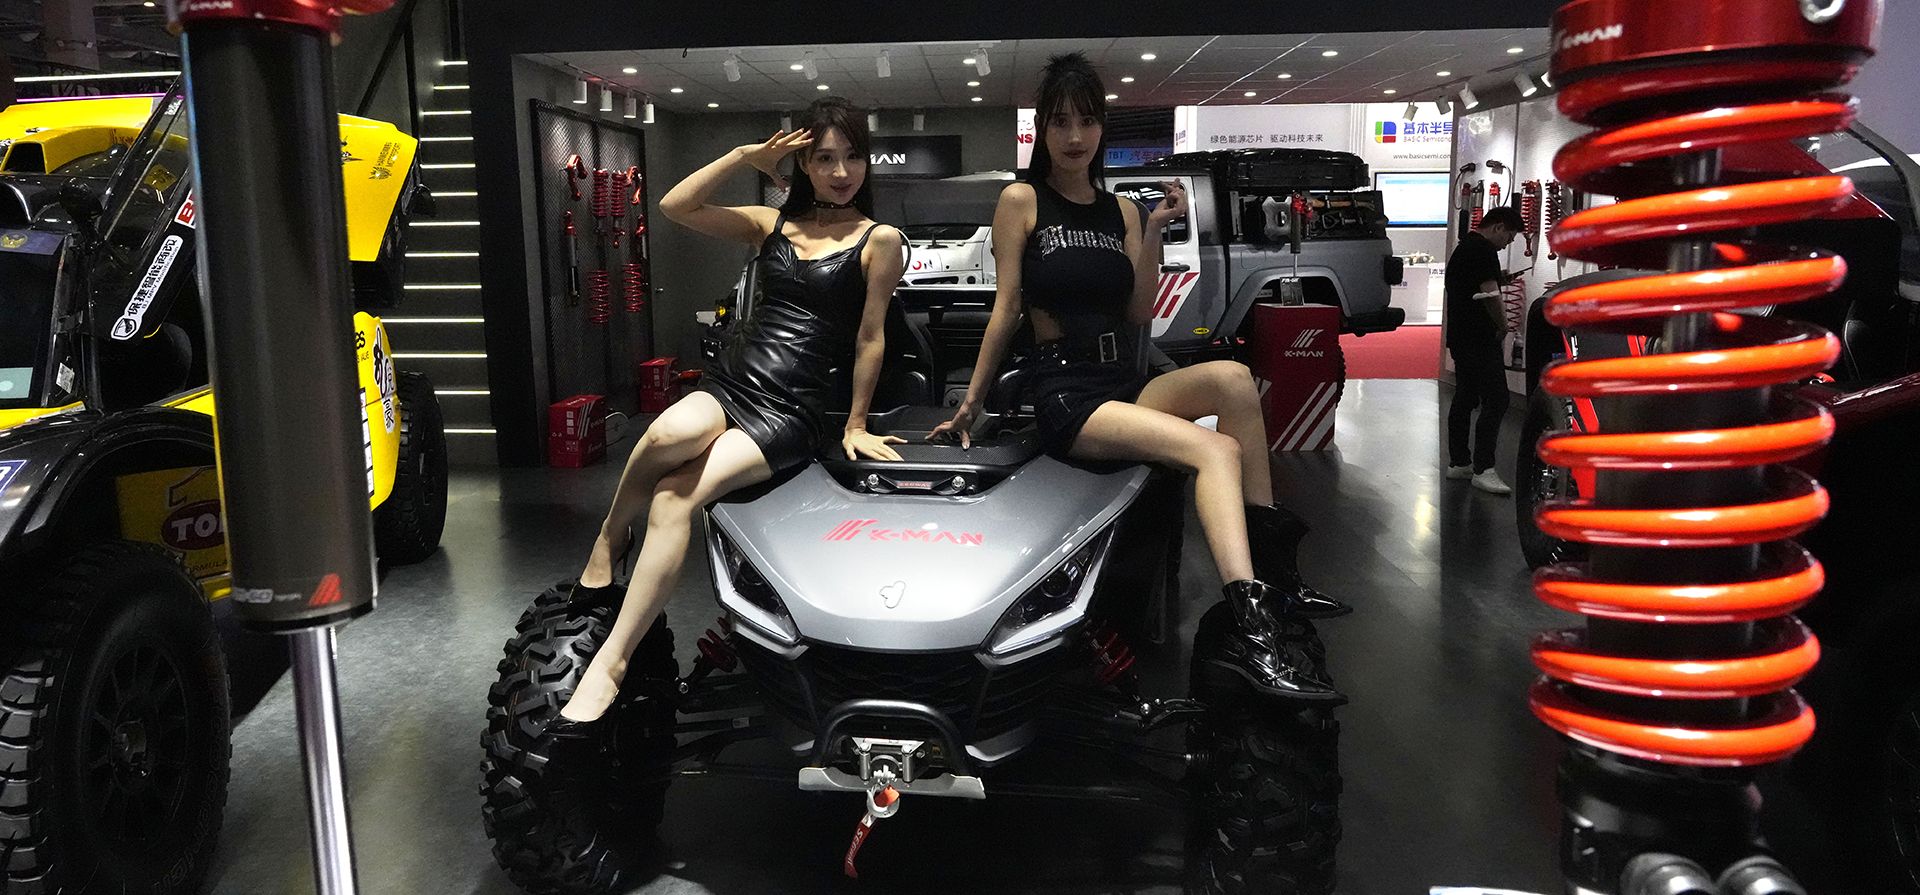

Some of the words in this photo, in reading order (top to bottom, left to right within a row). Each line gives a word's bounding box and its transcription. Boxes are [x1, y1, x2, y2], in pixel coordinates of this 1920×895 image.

[1210, 134, 1264, 144] 绿色能源芯片
[1270, 134, 1324, 144] 驱动科技未来
[1284, 350, 1325, 358] K-MAN
[868, 528, 985, 546] K-MAN
